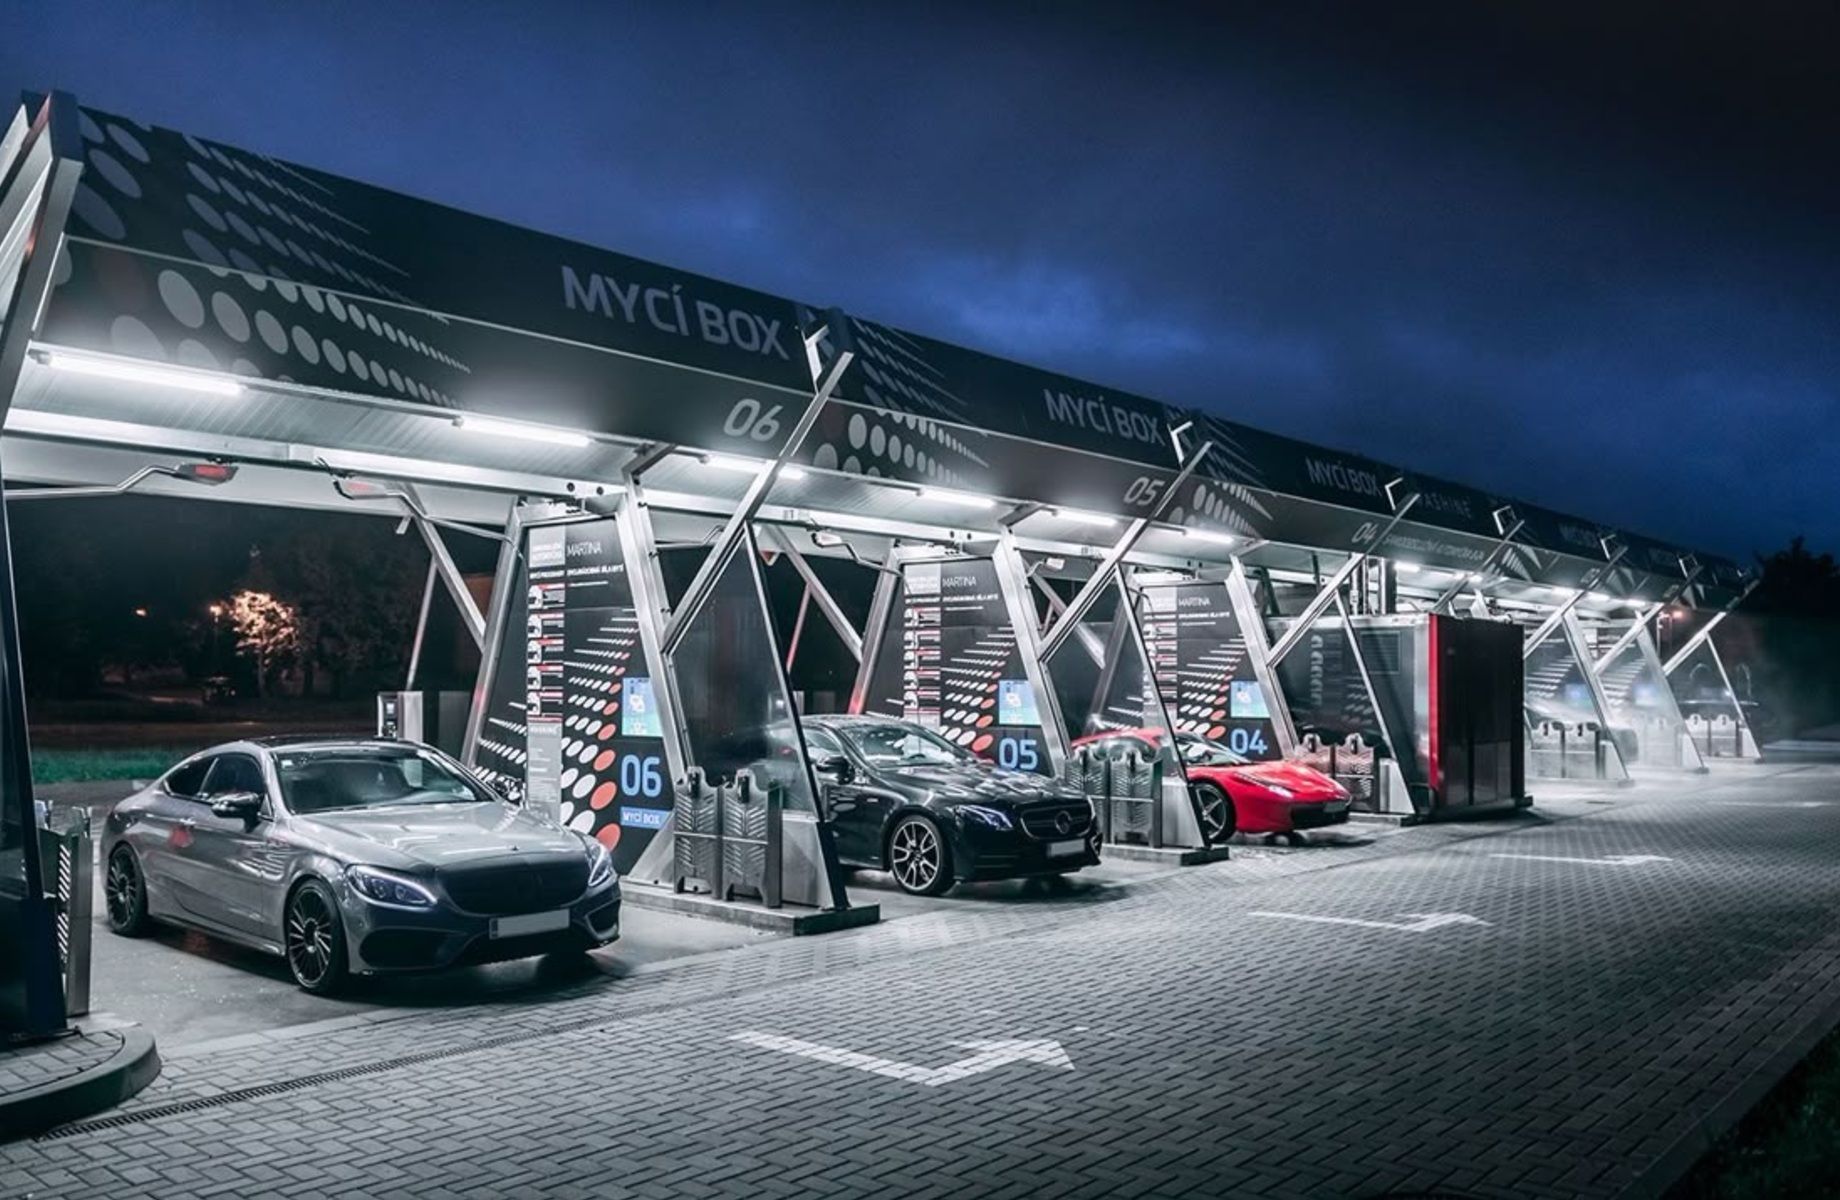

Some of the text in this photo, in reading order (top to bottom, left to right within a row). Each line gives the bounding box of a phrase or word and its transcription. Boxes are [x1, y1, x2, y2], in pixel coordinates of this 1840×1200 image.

[561, 265, 790, 360] MYCÍ BOX
[722, 398, 783, 442] 06
[1044, 388, 1166, 446] MYCÍ BOX
[1123, 476, 1165, 505] 05
[1346, 467, 1383, 497] BOX
[1351, 521, 1379, 545] 04
[942, 575, 977, 587] MARTINA
[1000, 737, 1038, 770] 05
[1230, 728, 1268, 754] 04
[621, 754, 663, 798] 06
[642, 813, 661, 825] BOX
